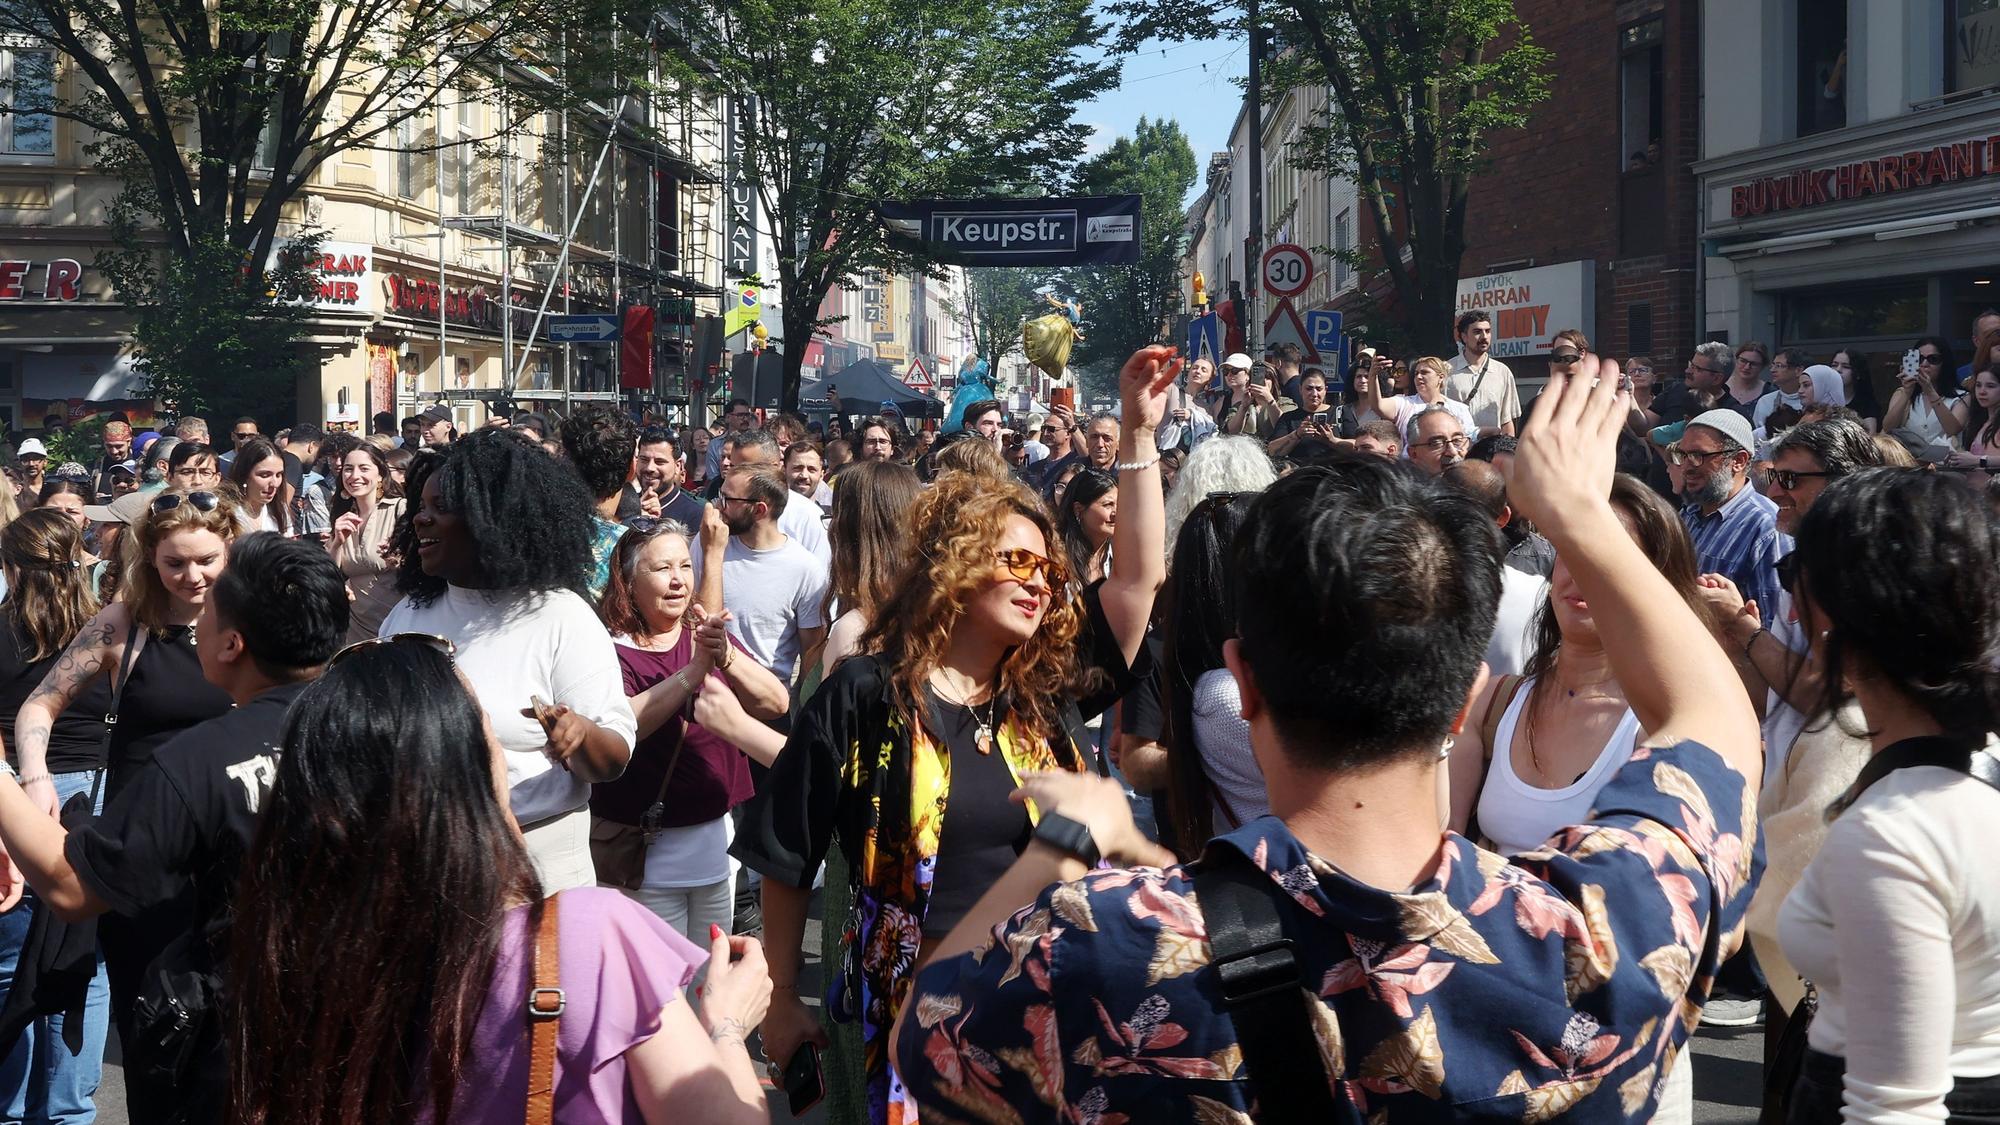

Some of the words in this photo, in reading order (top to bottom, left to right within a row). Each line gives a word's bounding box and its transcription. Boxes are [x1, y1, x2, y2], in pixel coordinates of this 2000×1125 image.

[1731, 168, 1832, 218] BÜYÜK
[1835, 140, 1980, 200] HARRAN
[942, 217, 1065, 247] Keupstr.
[1270, 259, 1302, 283] 30
[1476, 275, 1513, 290] BÜYÜK
[1460, 285, 1531, 310] HARRAN
[1313, 316, 1333, 345] P
